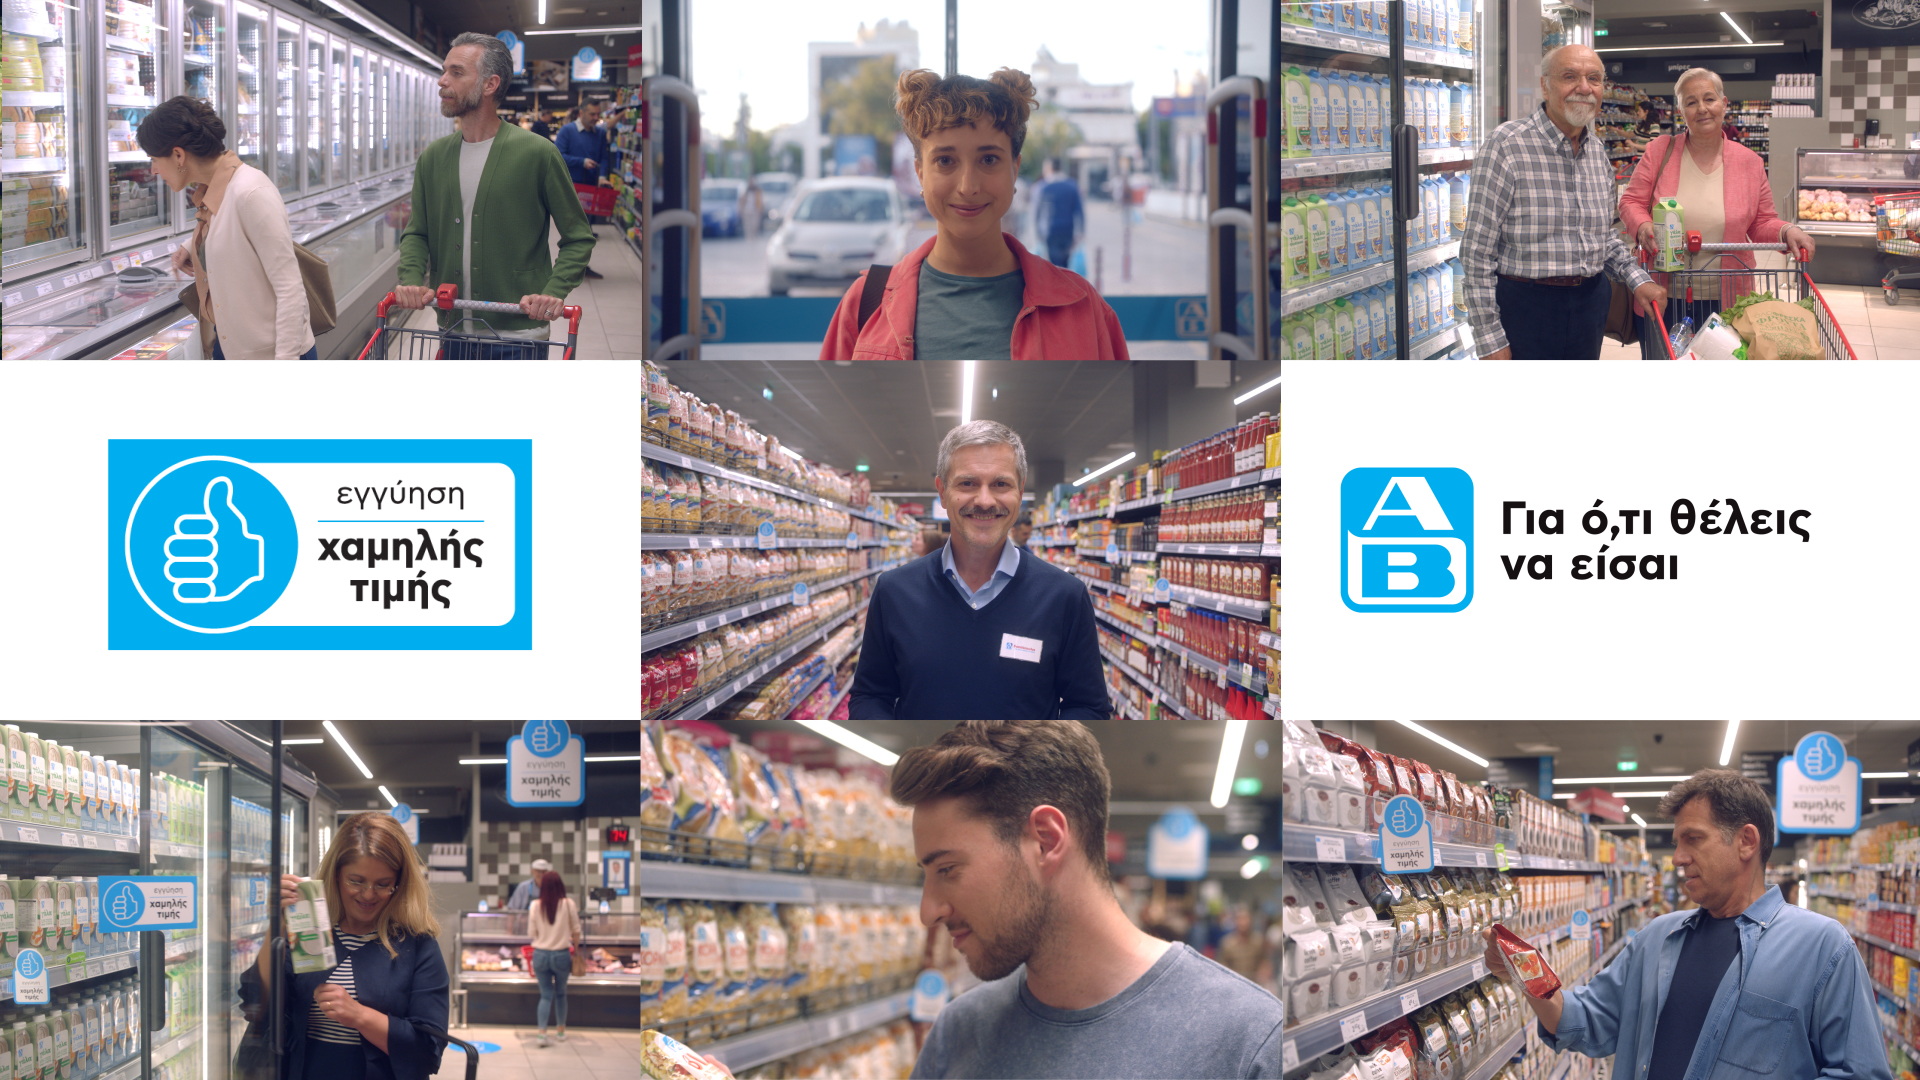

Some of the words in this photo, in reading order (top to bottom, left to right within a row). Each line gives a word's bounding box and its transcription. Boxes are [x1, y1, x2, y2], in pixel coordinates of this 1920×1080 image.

[1668, 63, 1690, 72] μπίρες
[527, 760, 565, 769] εγγύηση
[521, 774, 571, 786] χαμηλής
[530, 787, 561, 798] τιμής
[1798, 784, 1841, 793] εγγύηση
[1793, 798, 1846, 812] χαμηλής
[1802, 812, 1835, 824] τιμής
[612, 830, 627, 842] 74
[1393, 840, 1419, 848] εγγύηση
[1390, 850, 1424, 859] χαμηλής
[1397, 858, 1418, 868] τιμής
[153, 887, 183, 895] εγγύηση
[149, 898, 187, 909] χαμηλής
[157, 909, 180, 920] τιμής
